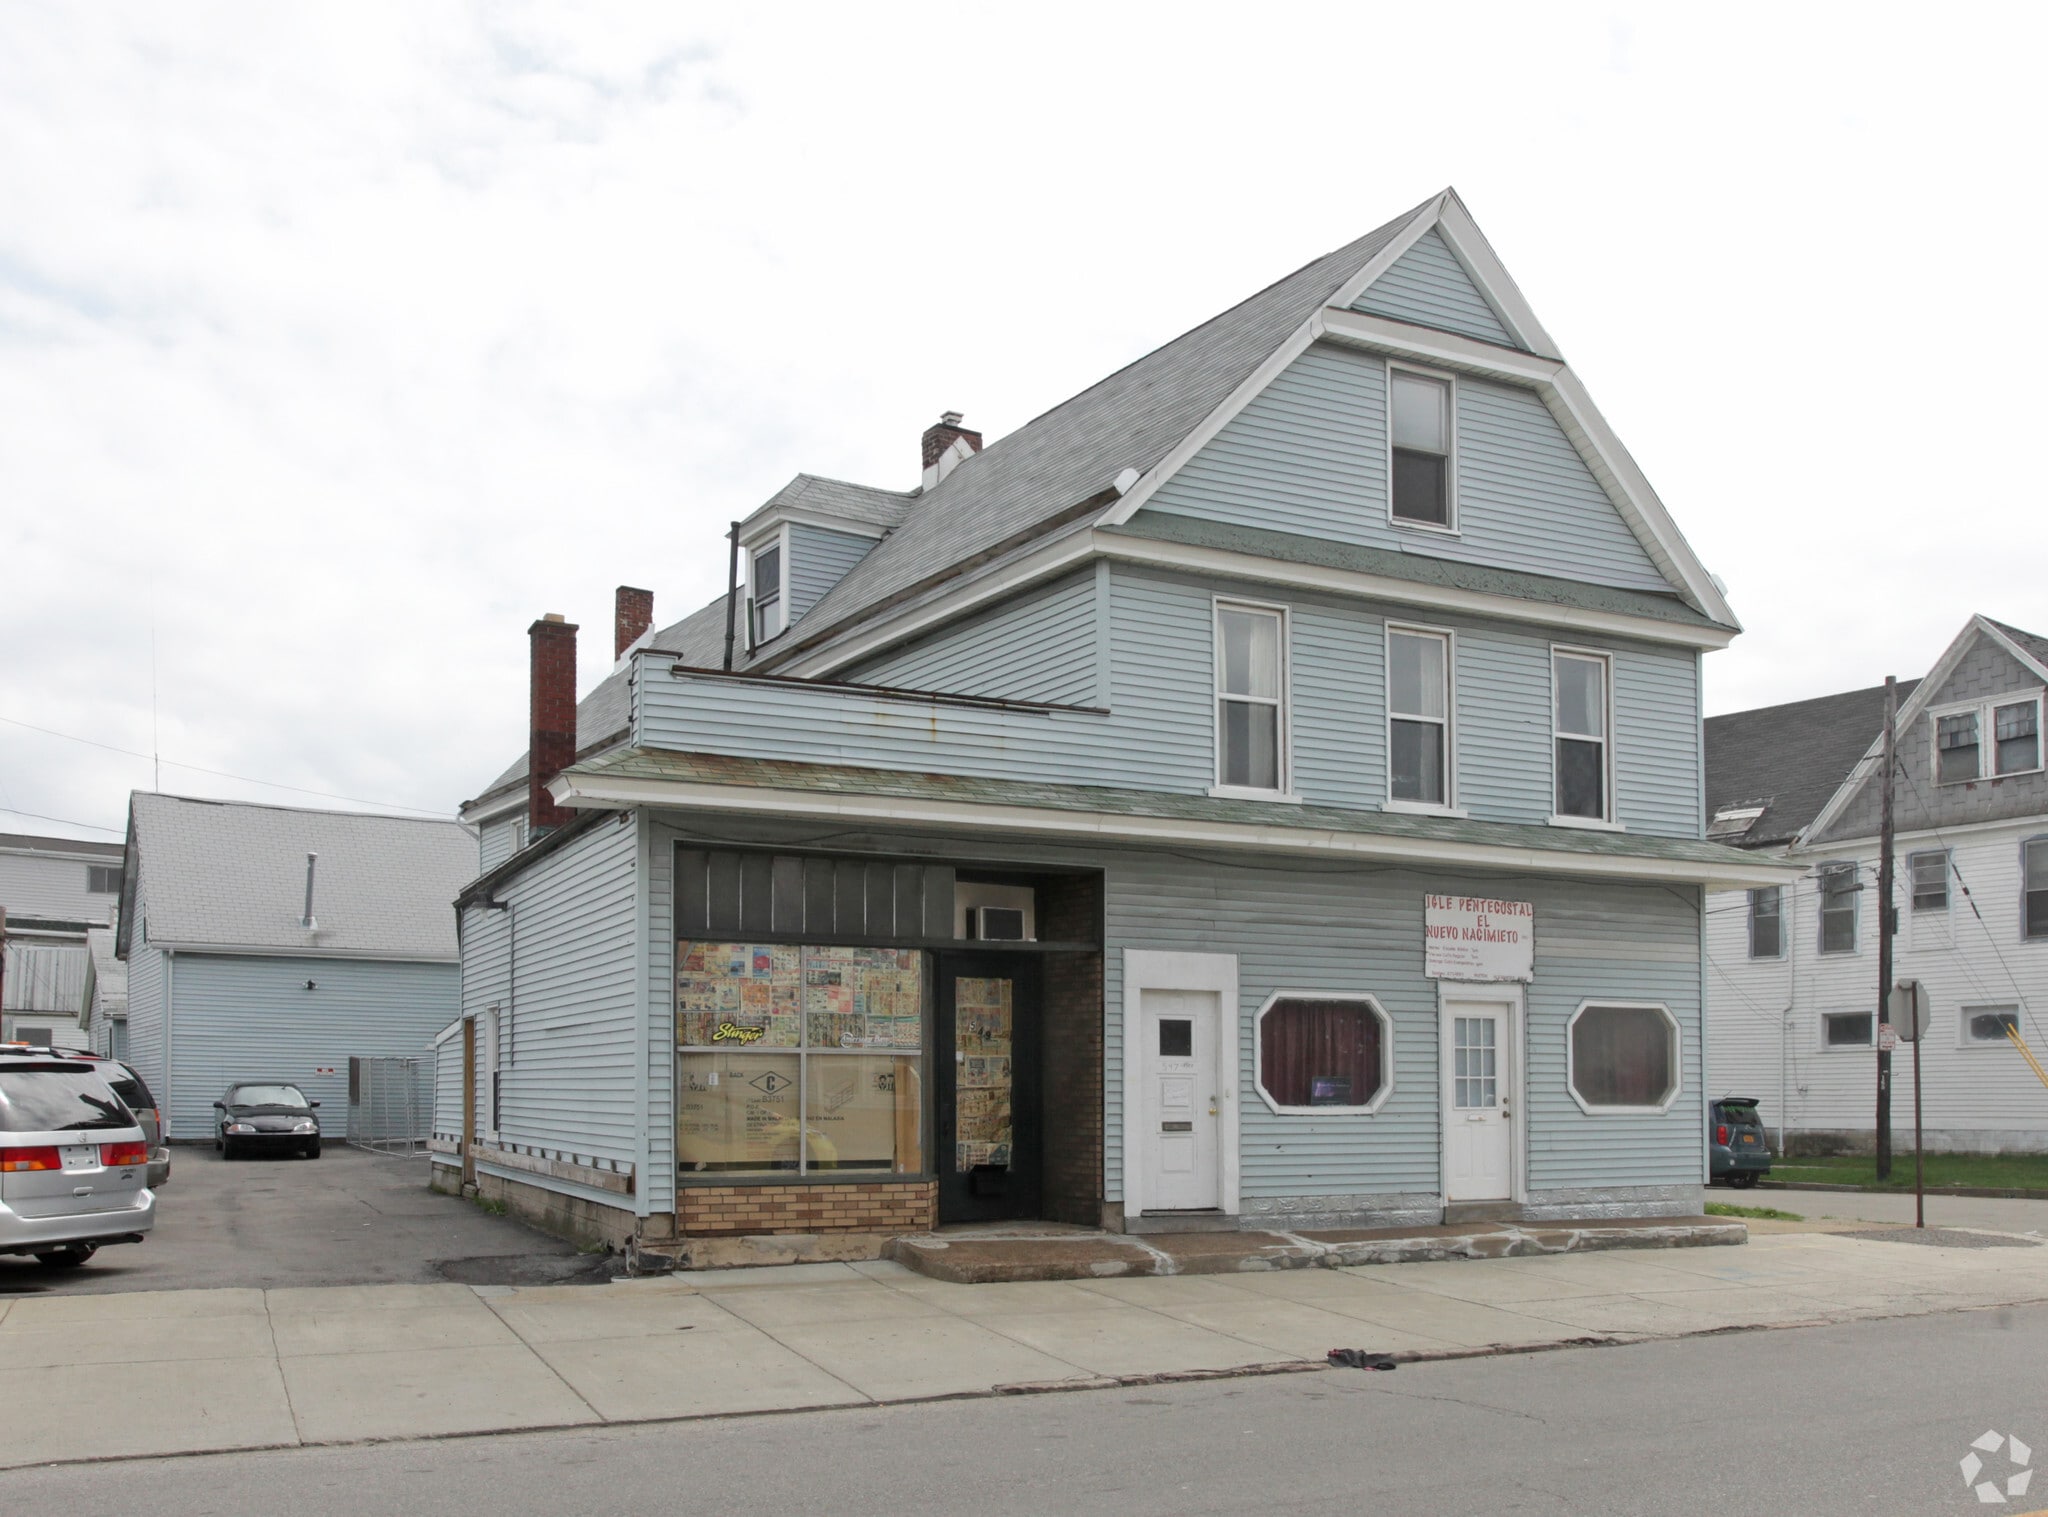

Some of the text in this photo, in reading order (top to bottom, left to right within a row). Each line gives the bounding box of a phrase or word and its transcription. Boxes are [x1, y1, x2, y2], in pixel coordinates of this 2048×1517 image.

[1426, 895, 1532, 917] IGLE PENTECOSTAL
[1477, 915, 1491, 928] EL
[1426, 925, 1519, 944] NUEVO NACIMIETO
[712, 1022, 764, 1046] Stinger
[766, 1075, 775, 1091] C
